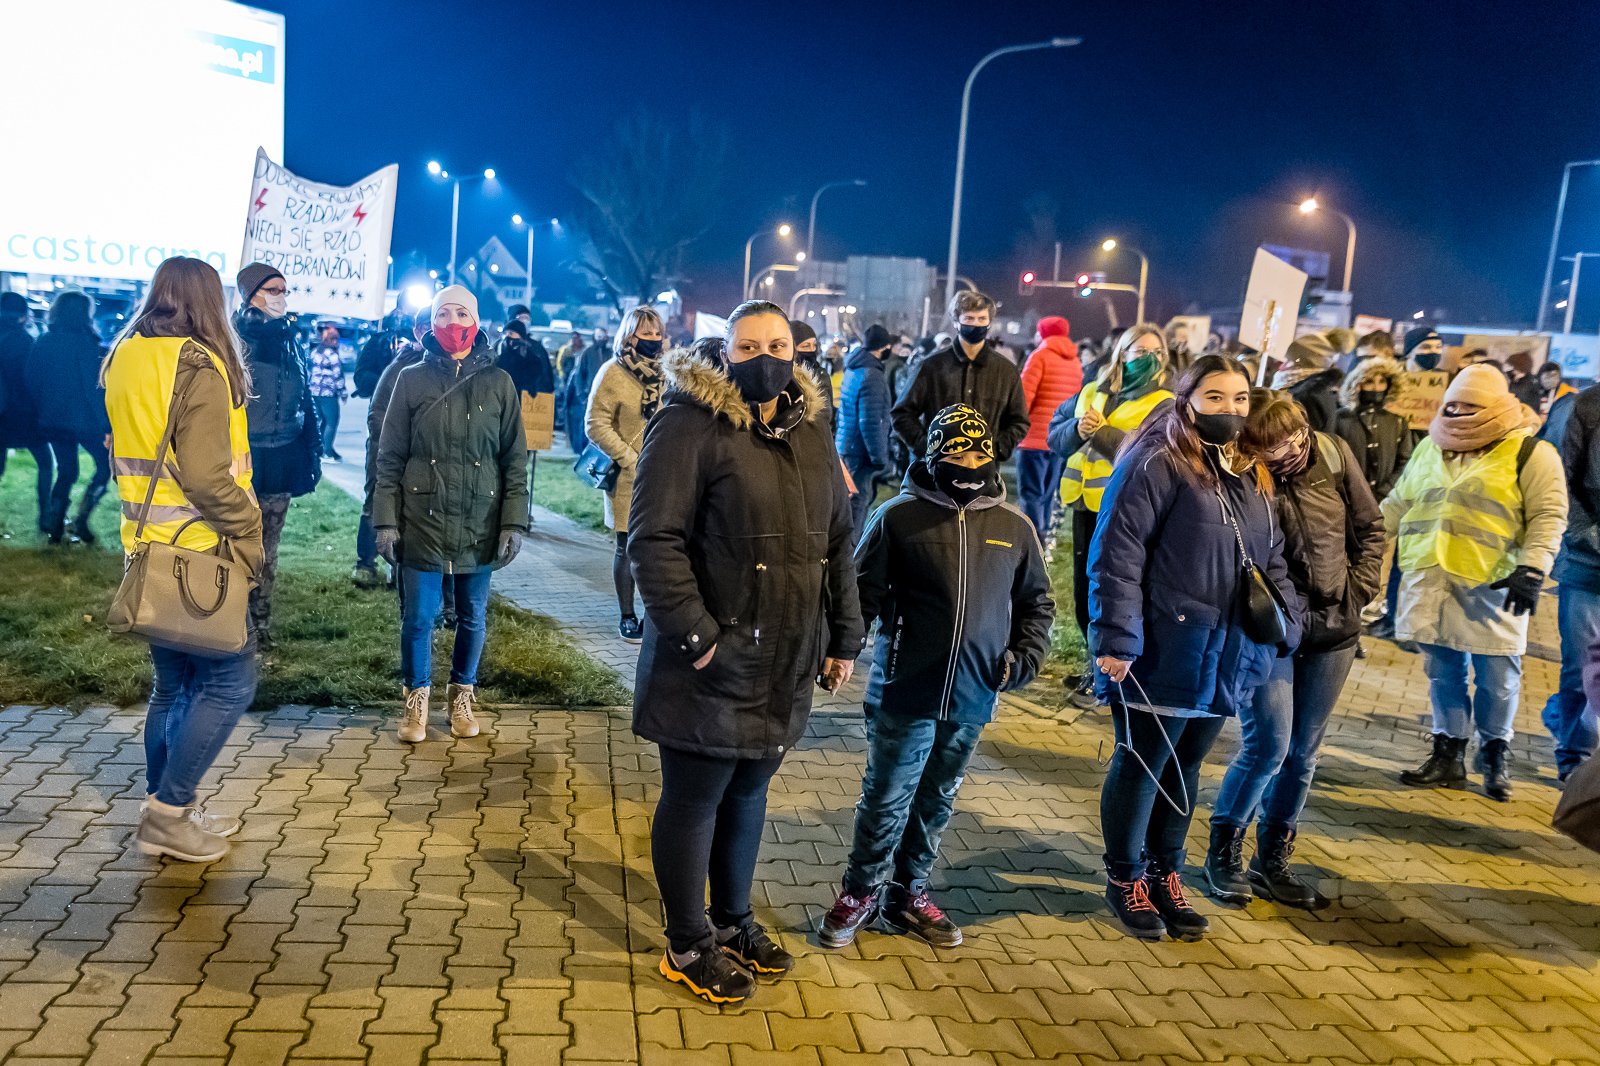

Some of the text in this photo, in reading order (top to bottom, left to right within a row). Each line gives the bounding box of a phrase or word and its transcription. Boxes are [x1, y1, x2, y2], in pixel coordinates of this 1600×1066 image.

[255, 156, 310, 199] DOB
[245, 217, 362, 254] NIECH SIĘ RZĄD
